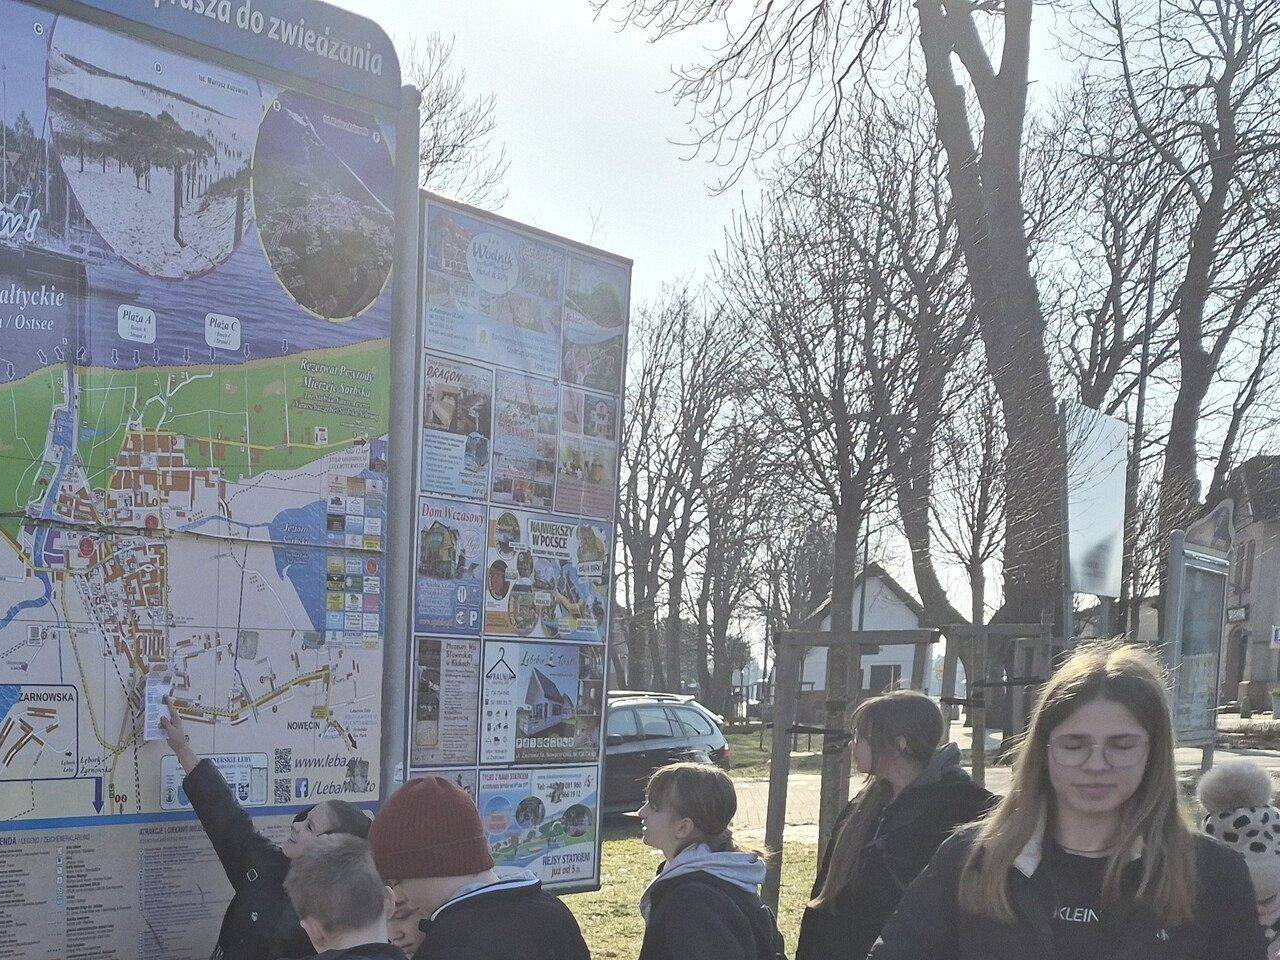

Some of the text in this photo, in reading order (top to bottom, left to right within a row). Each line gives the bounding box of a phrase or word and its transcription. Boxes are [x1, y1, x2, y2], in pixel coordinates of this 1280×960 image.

[236, 0, 384, 76] do zwiedzania
[14, 314, 54, 332] Ostsee
[340, 366, 374, 383] Przyrody
[426, 365, 462, 383] DRAGON
[422, 503, 485, 528] Dom Wczasowy
[287, 721, 320, 731] NOWĘCIN
